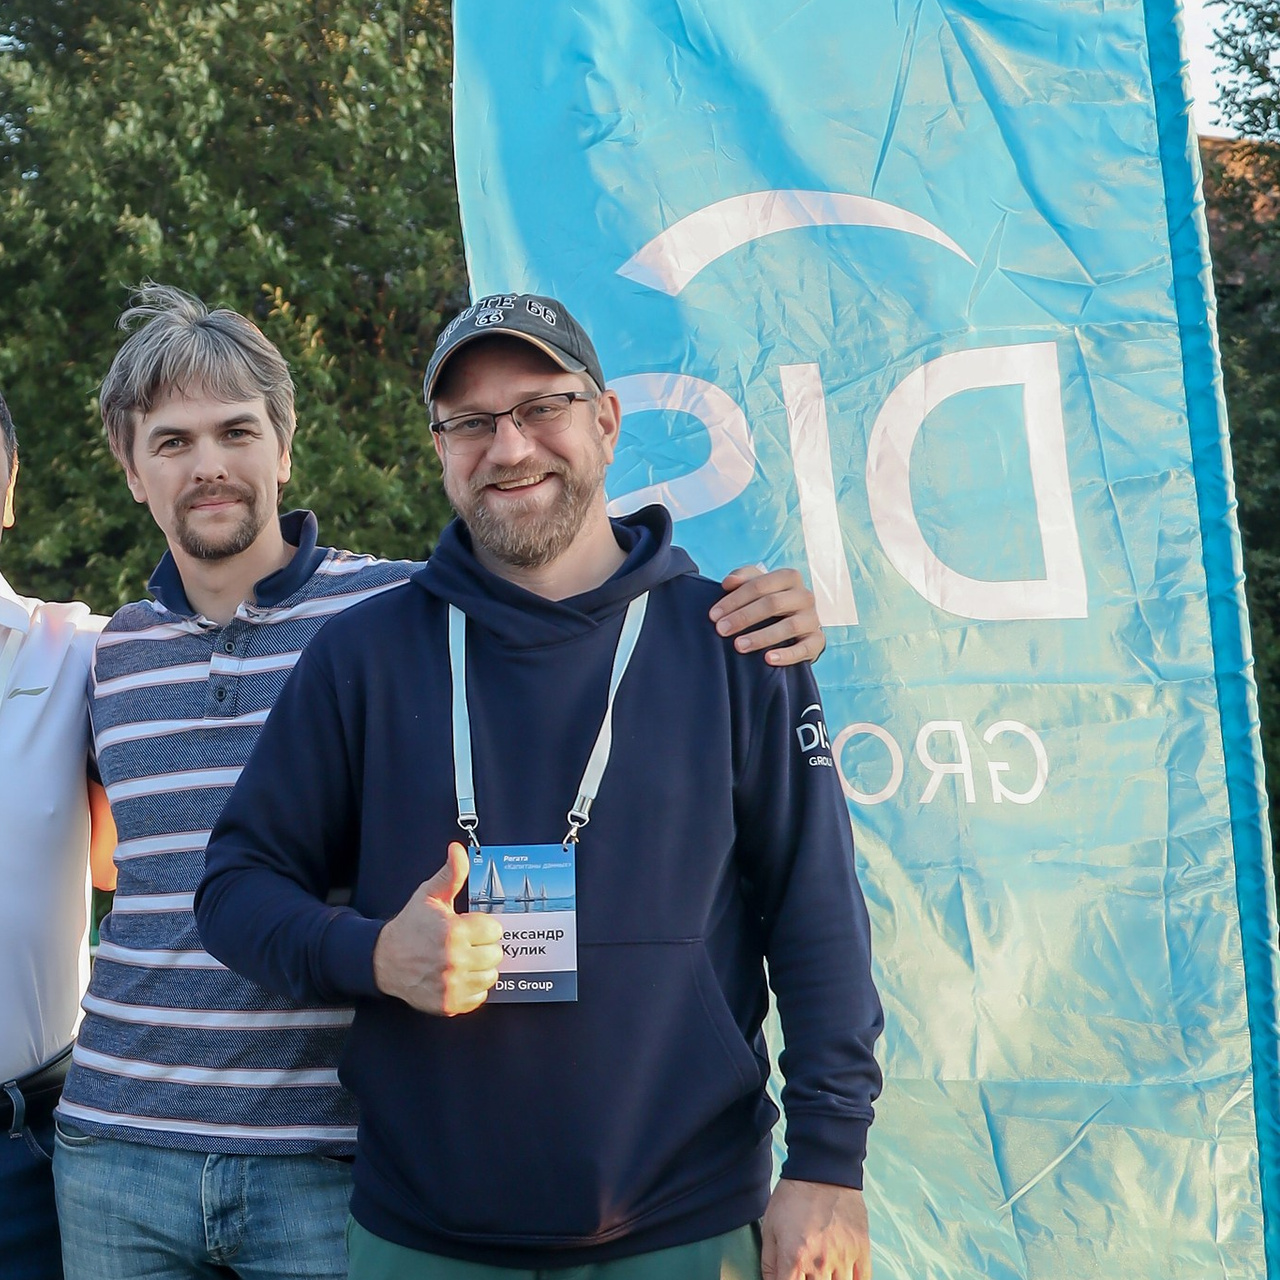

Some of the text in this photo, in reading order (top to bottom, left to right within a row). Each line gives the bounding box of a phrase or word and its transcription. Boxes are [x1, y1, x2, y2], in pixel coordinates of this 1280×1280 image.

[526, 299, 557, 326] 66
[478, 313, 501, 325] 66
[501, 929, 565, 941] ександр
[501, 944, 547, 959] Кулик
[495, 980, 554, 992] DIS Group
